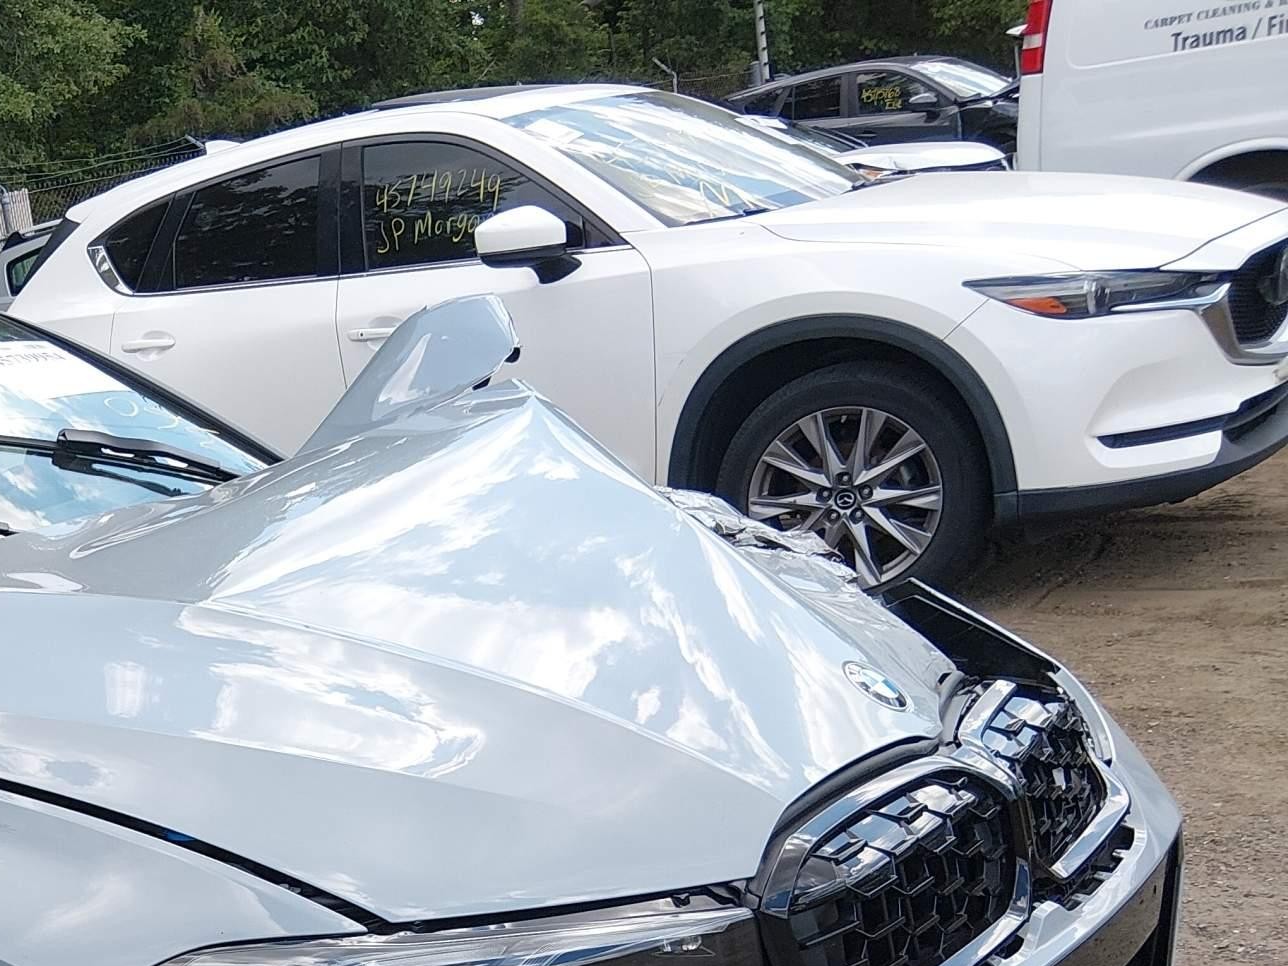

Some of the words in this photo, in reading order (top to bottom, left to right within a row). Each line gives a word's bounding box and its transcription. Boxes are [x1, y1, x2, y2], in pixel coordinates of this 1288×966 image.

[1143, 12, 1193, 30] CARPET
[1196, 0, 1261, 21] CLEANING
[1170, 25, 1248, 52] Trauma
[376, 216, 406, 254] JP
[414, 211, 495, 244] Morga
